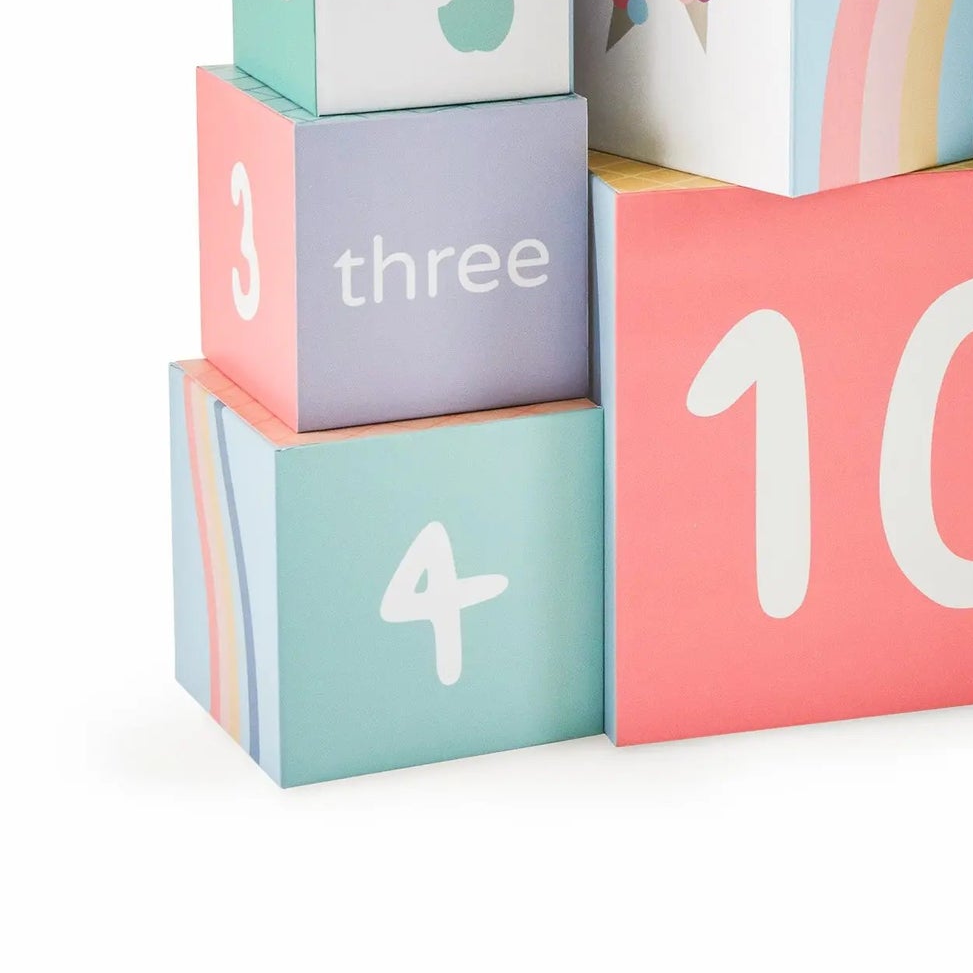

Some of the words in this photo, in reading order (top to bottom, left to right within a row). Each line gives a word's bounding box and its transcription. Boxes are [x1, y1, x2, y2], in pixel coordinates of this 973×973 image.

[230, 161, 263, 321] 3
[333, 234, 550, 308] three
[379, 520, 509, 686] 4
